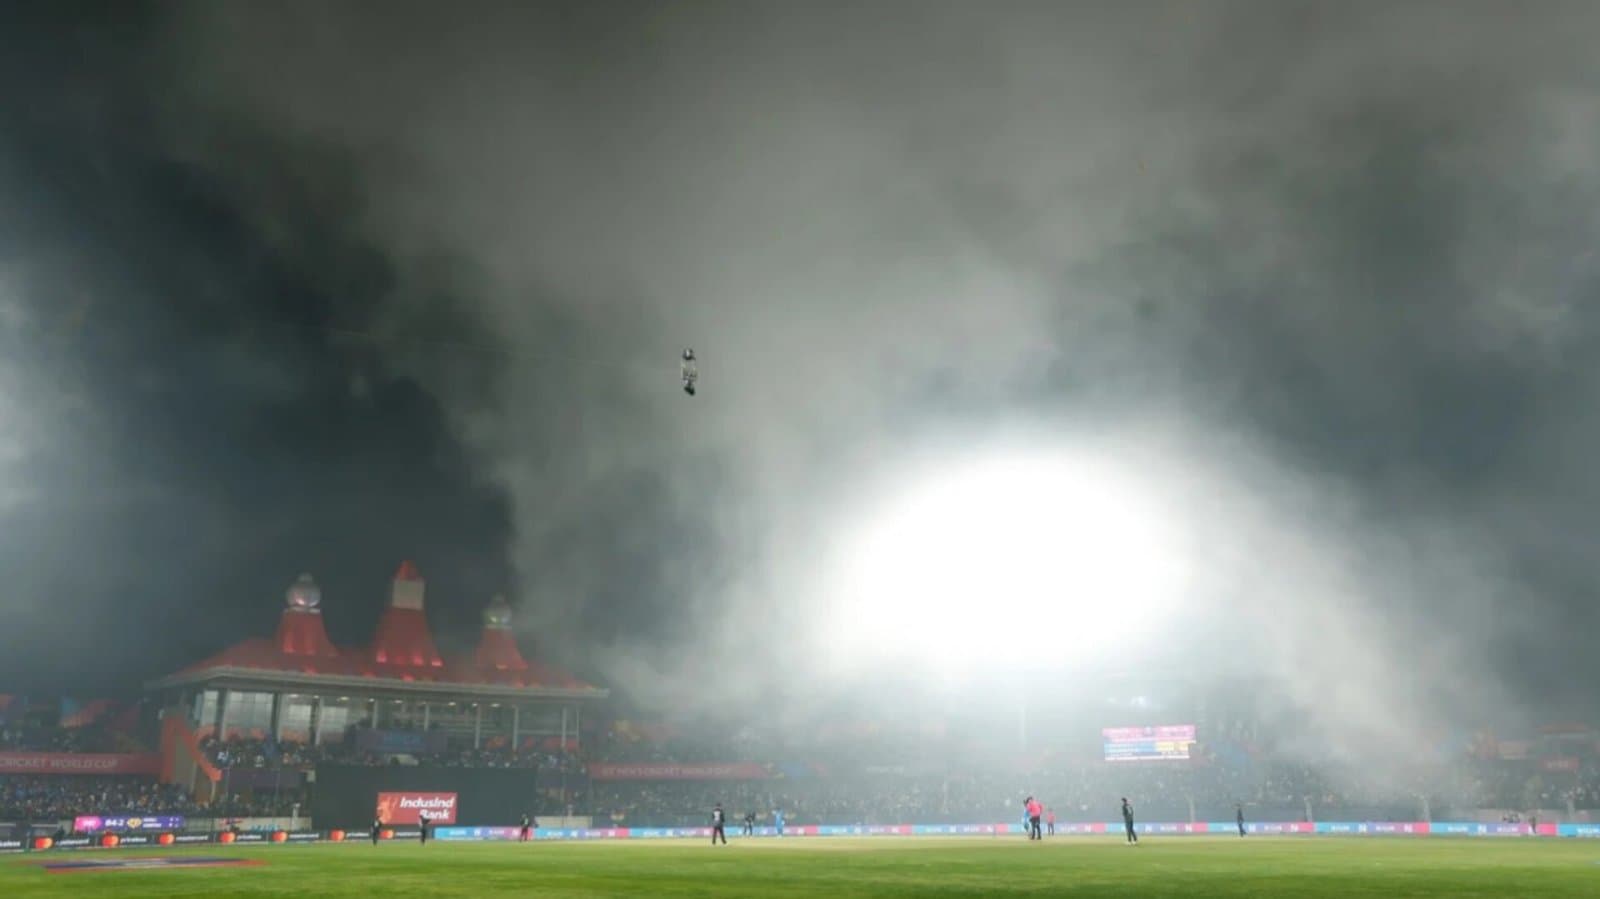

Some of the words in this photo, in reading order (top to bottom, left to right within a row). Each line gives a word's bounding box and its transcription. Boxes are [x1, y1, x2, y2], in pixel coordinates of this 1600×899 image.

[0, 757, 46, 768] CRICKET
[50, 757, 93, 769] WORLD
[94, 758, 119, 769] CUP
[400, 796, 456, 808] IndusInd
[420, 809, 450, 820] Bank
